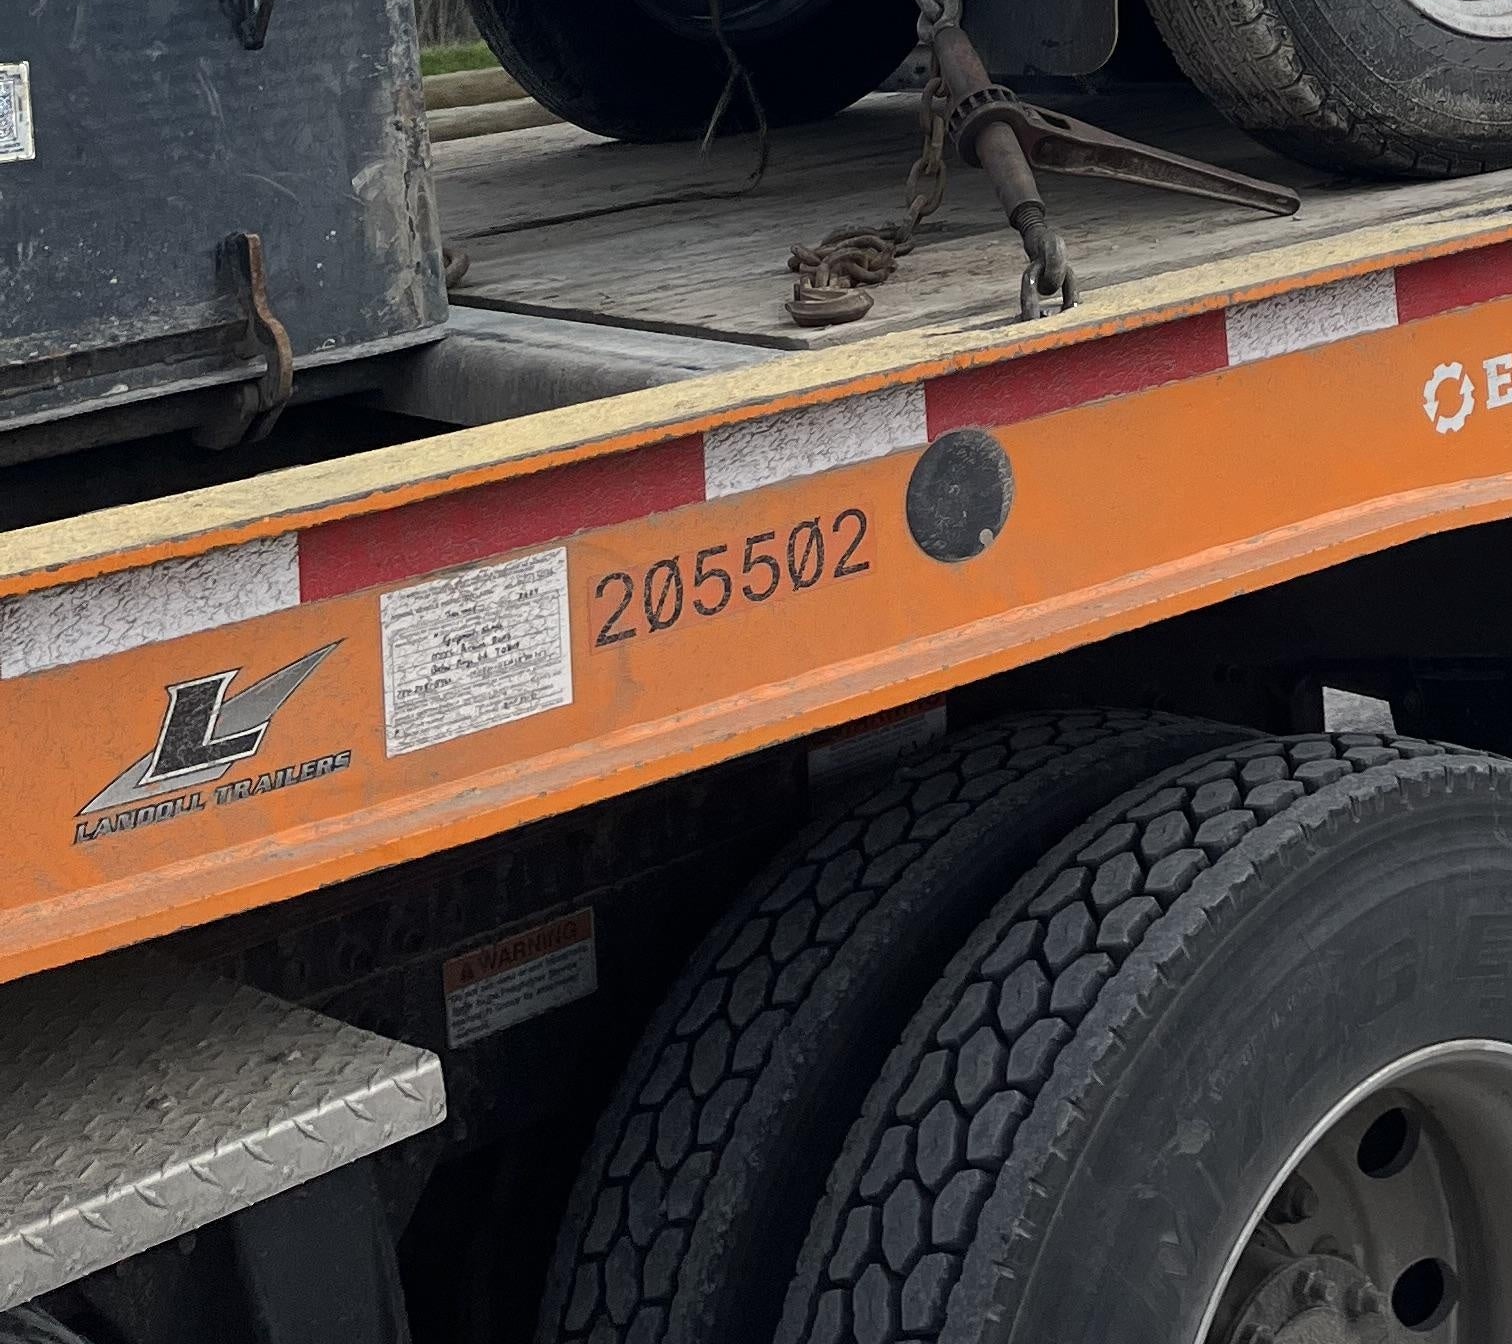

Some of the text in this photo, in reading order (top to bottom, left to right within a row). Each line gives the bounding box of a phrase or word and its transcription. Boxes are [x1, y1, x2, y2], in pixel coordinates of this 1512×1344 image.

[595, 508, 870, 648] 205502
[72, 749, 352, 845] LANDOLL TRAILERS
[479, 918, 579, 972] WARNING
